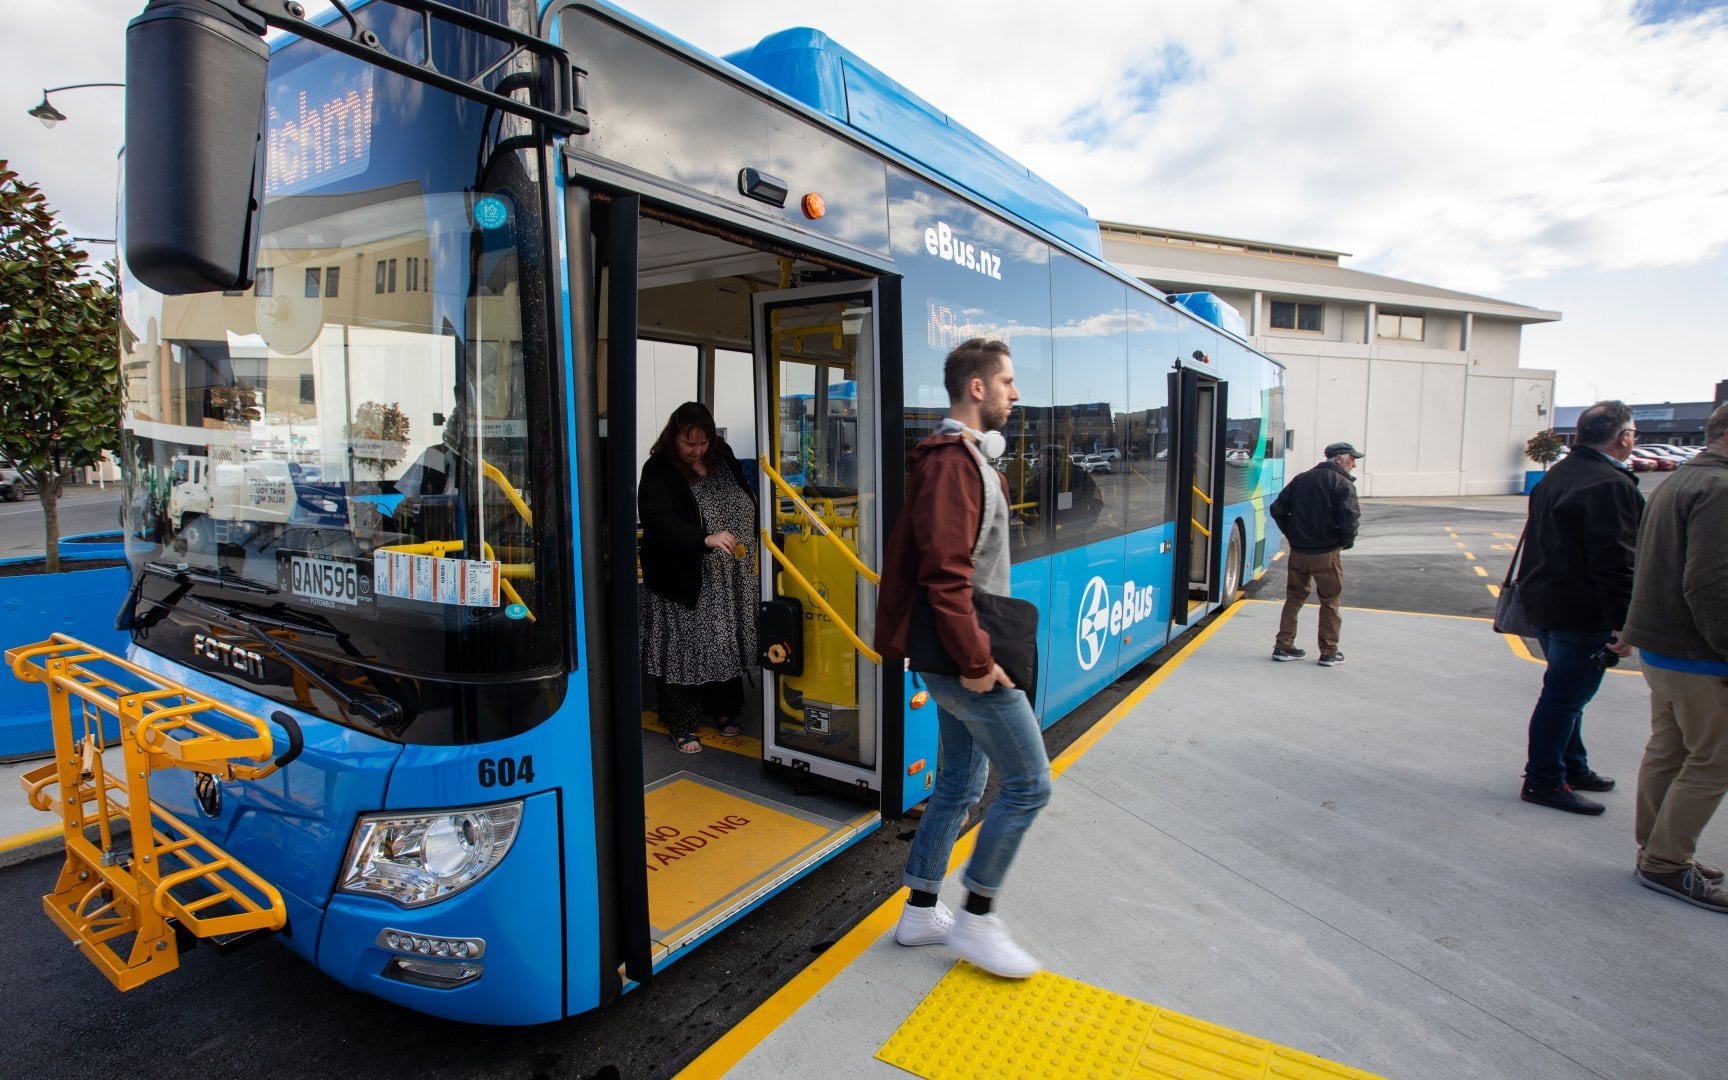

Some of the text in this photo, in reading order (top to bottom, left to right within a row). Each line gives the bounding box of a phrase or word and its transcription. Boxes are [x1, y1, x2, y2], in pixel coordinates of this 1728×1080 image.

[265, 87, 373, 194] ichm
[924, 220, 1002, 281] eBus.nz
[292, 560, 356, 600] QAN596
[1110, 580, 1153, 636] eBus
[478, 755, 535, 788] 604
[646, 825, 681, 847] NO
[646, 815, 752, 872] ANDING
